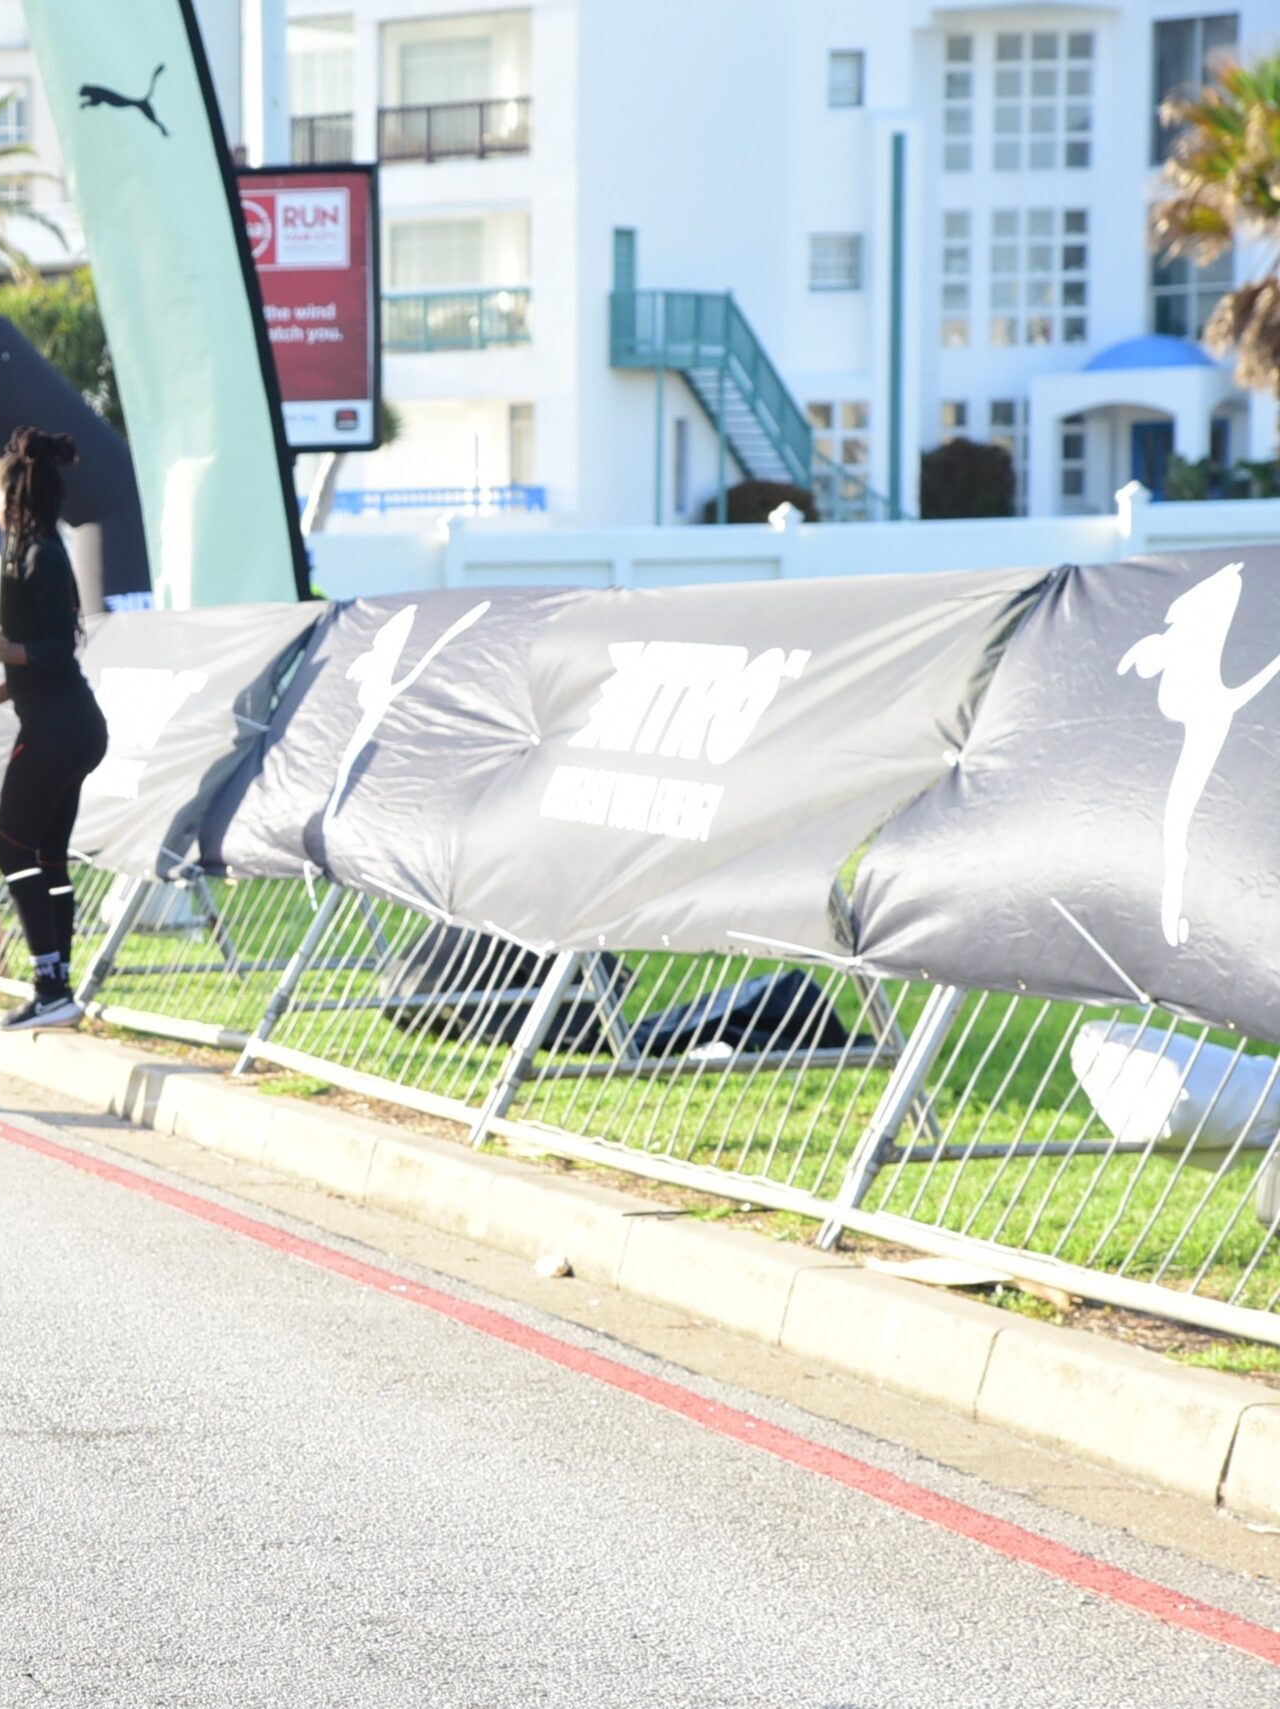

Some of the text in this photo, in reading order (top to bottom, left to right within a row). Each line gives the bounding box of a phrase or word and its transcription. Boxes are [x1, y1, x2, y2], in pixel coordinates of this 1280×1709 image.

[283, 206, 338, 228] RUN
[293, 303, 336, 321] wind
[306, 326, 344, 346] you.
